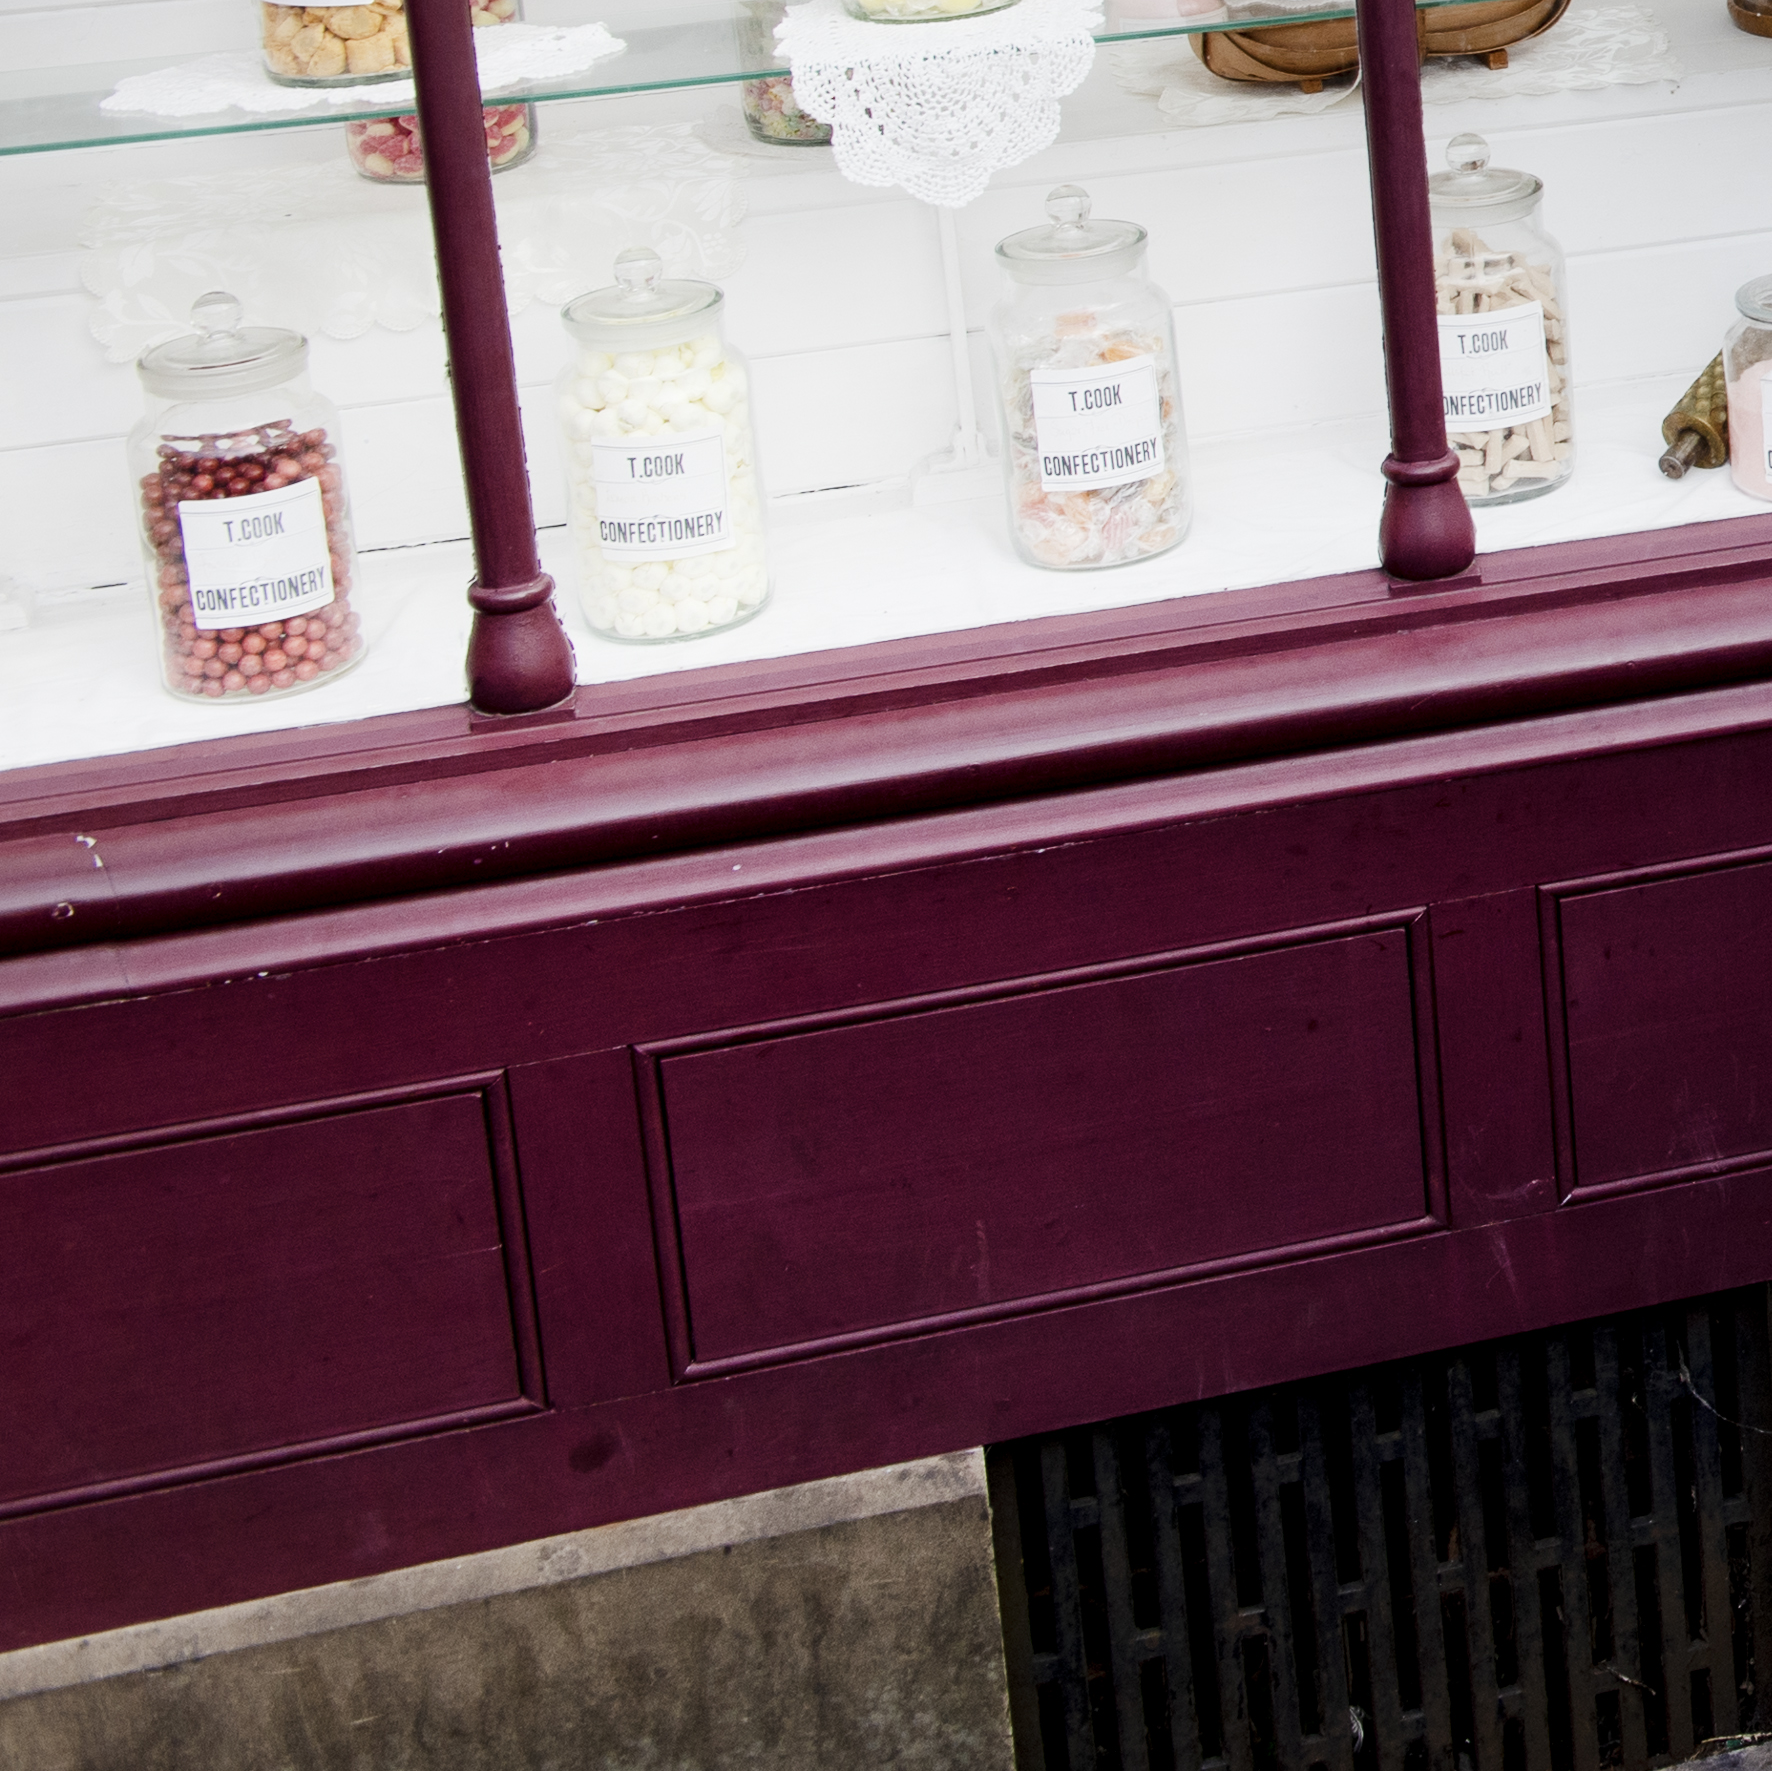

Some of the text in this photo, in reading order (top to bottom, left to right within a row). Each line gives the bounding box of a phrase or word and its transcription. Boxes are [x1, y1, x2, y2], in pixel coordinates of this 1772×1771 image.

[1457, 329, 1508, 355] T.COOK
[1068, 383, 1122, 412] T.COOK
[1443, 382, 1541, 416] ONFECTIONERY
[627, 453, 685, 478] T.COOK
[1043, 437, 1157, 476] CONFECTIONERY
[223, 511, 285, 543] T.COOK
[599, 510, 723, 543] CONFECTIONERY
[196, 565, 325, 611] CONFECTIONERY
